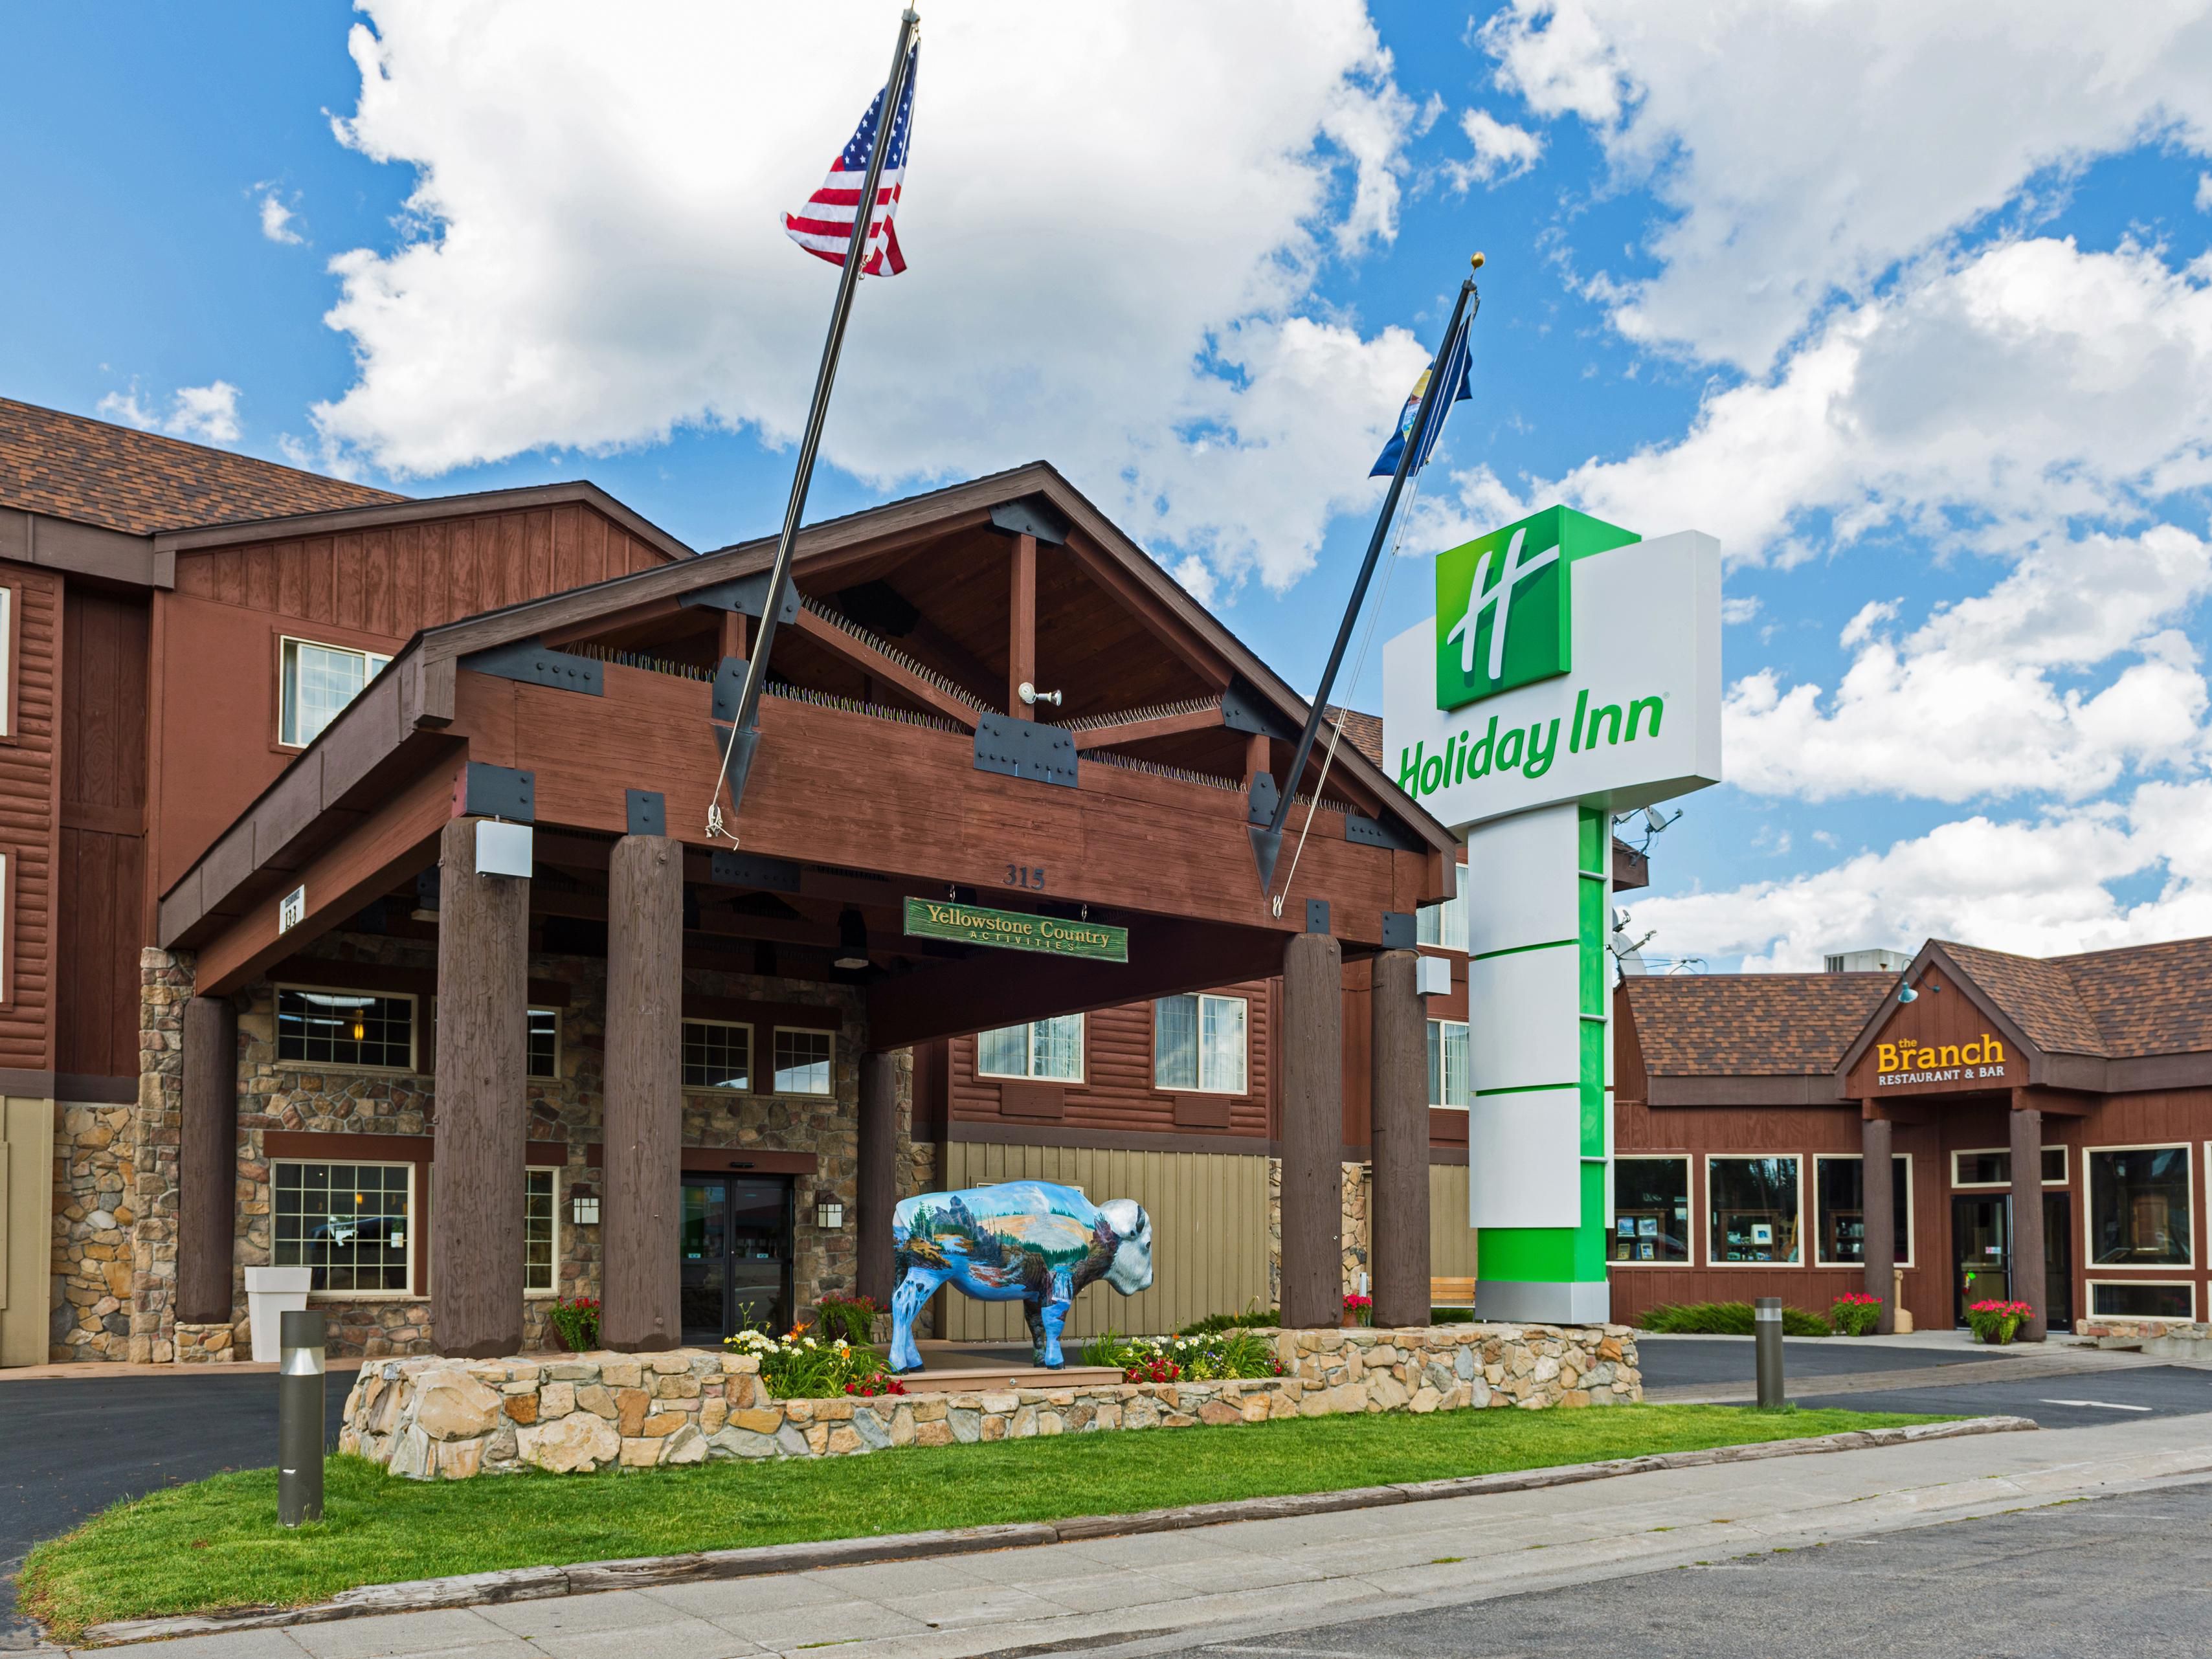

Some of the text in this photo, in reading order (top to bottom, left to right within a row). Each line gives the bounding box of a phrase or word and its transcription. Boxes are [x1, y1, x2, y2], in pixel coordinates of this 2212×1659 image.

[1397, 689, 1665, 799] Holiday Inn
[1003, 863, 1045, 890] 315
[926, 904, 1111, 948] Yellowstone Country
[970, 931, 1076, 952] ACTIVITIES
[1876, 1033, 2006, 1073] Branch
[1898, 1038, 1917, 1048] the
[1879, 1065, 2005, 1086] RESTAURANT & BAR
